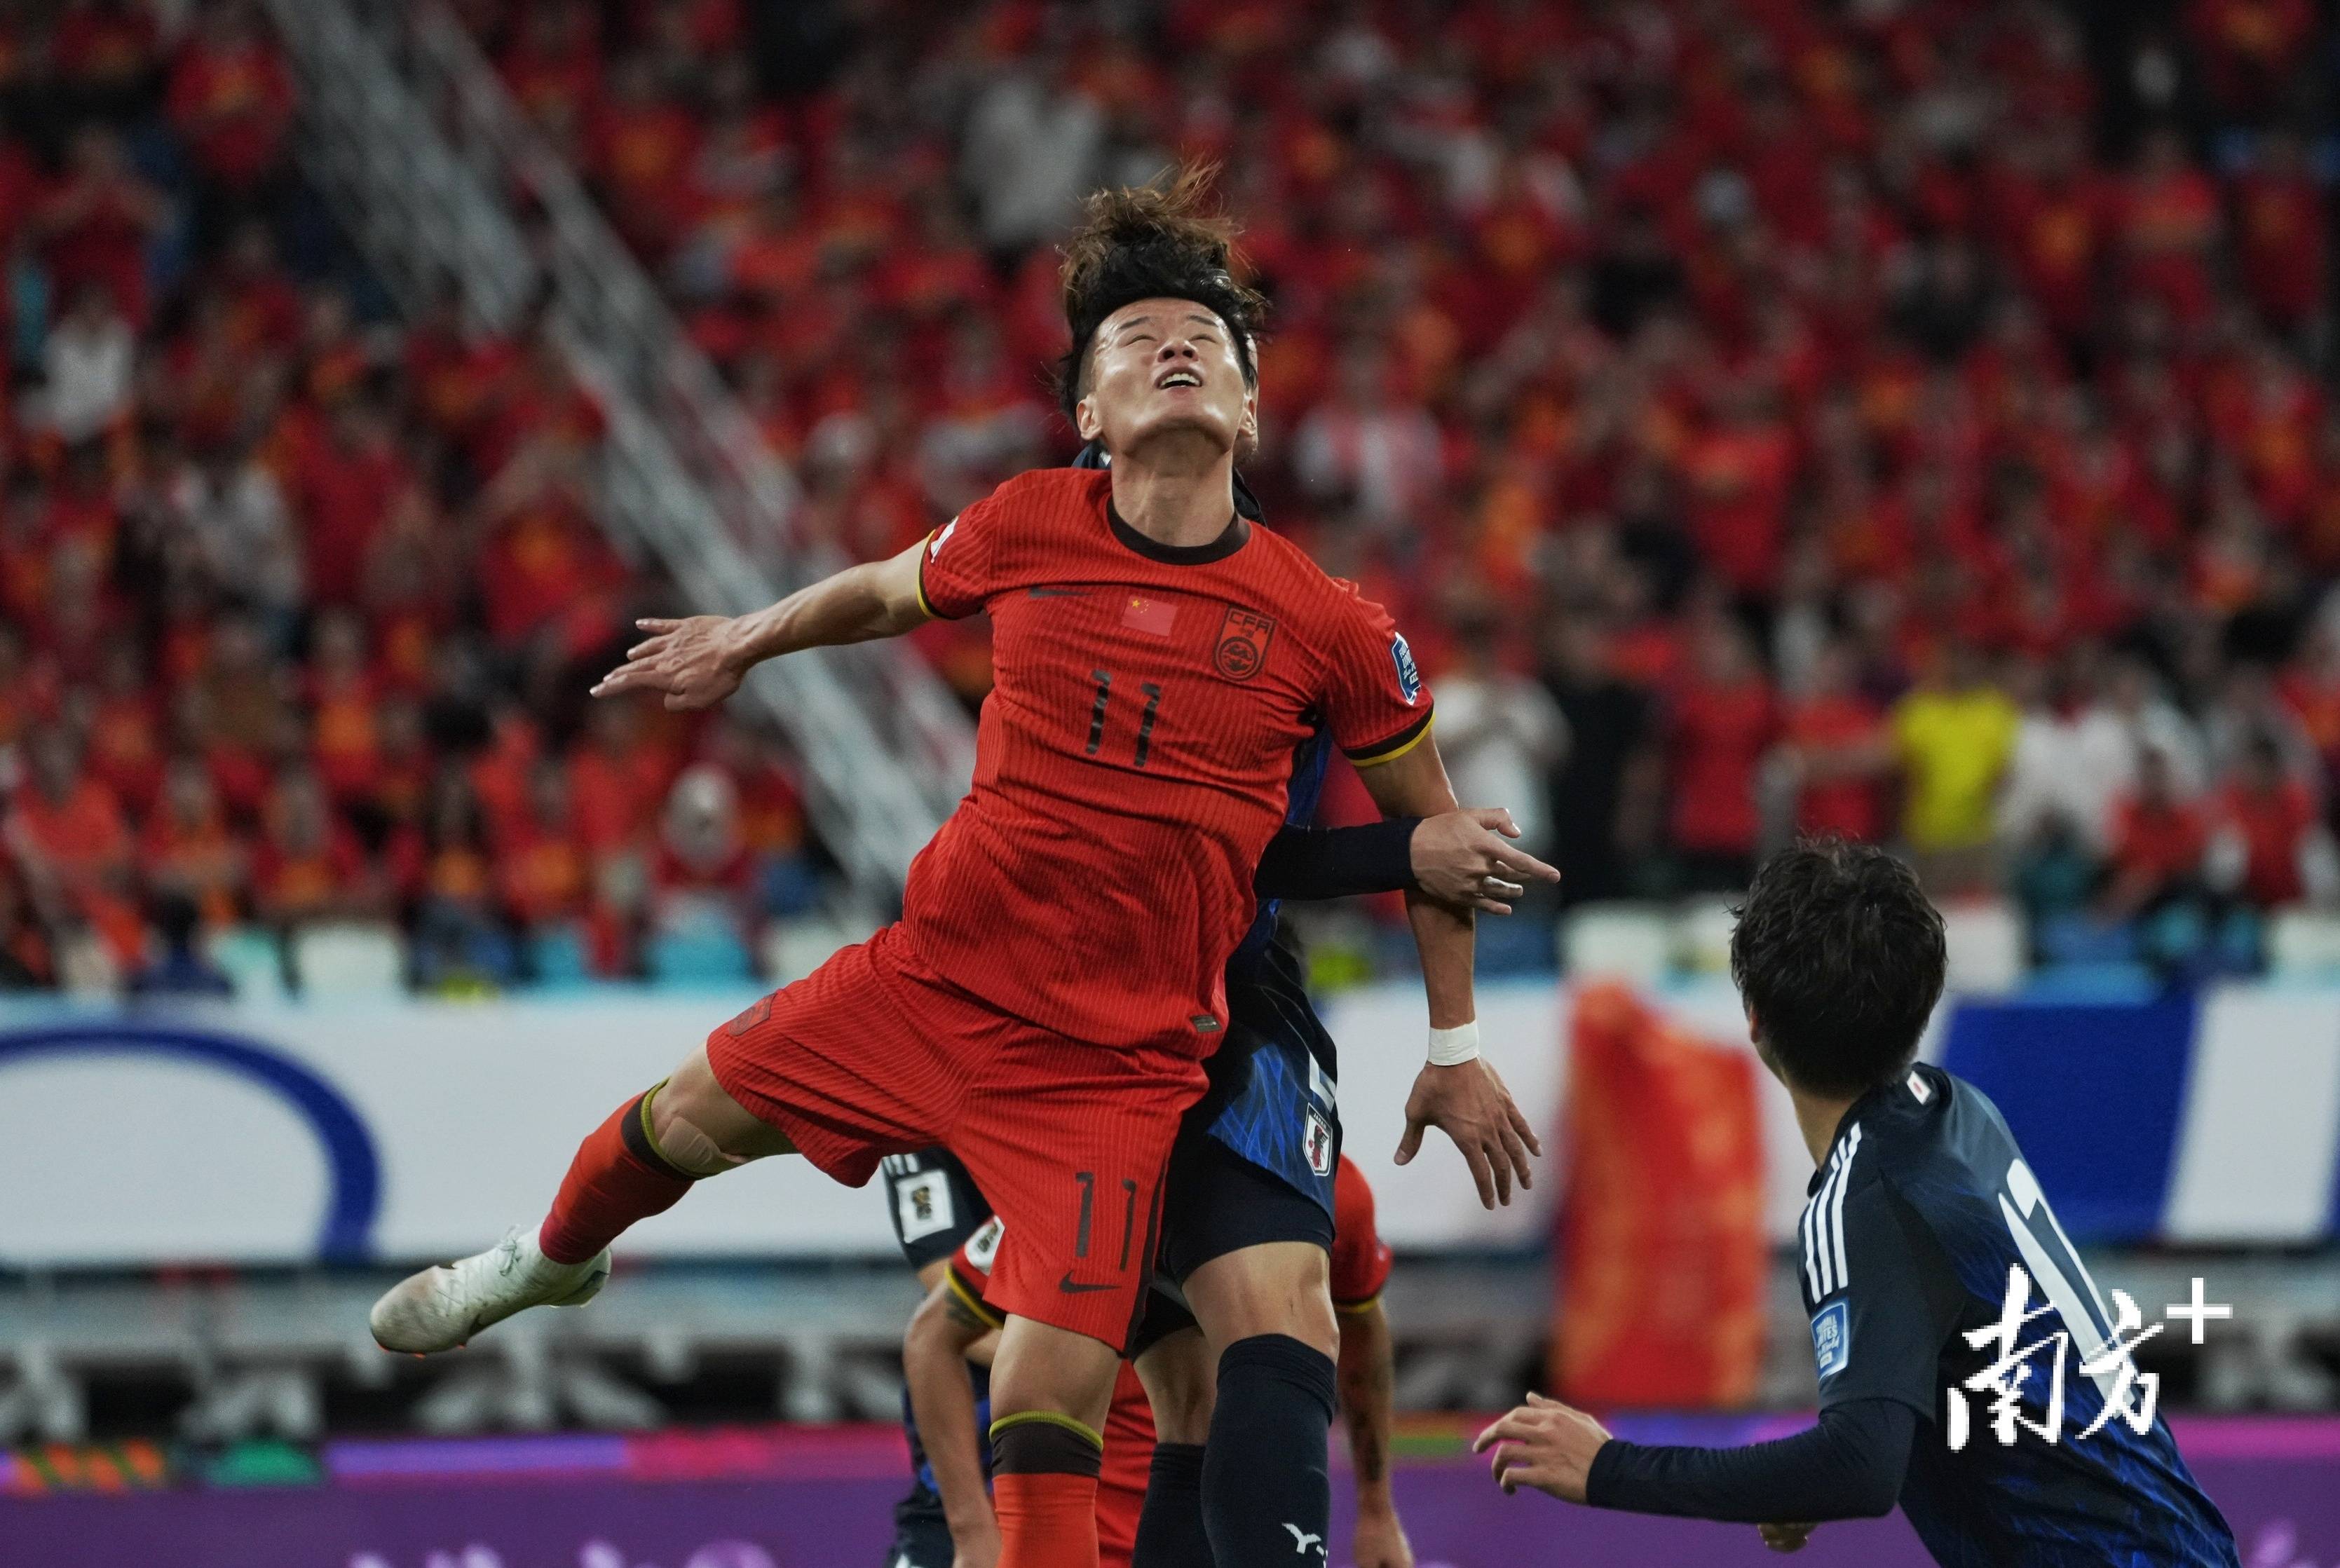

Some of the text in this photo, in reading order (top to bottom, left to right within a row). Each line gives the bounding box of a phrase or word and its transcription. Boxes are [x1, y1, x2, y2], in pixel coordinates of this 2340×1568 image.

[1087, 669, 1160, 767] 11
[1313, 1112, 1326, 1130] JAPAN
[1075, 1171, 1136, 1272] 11
